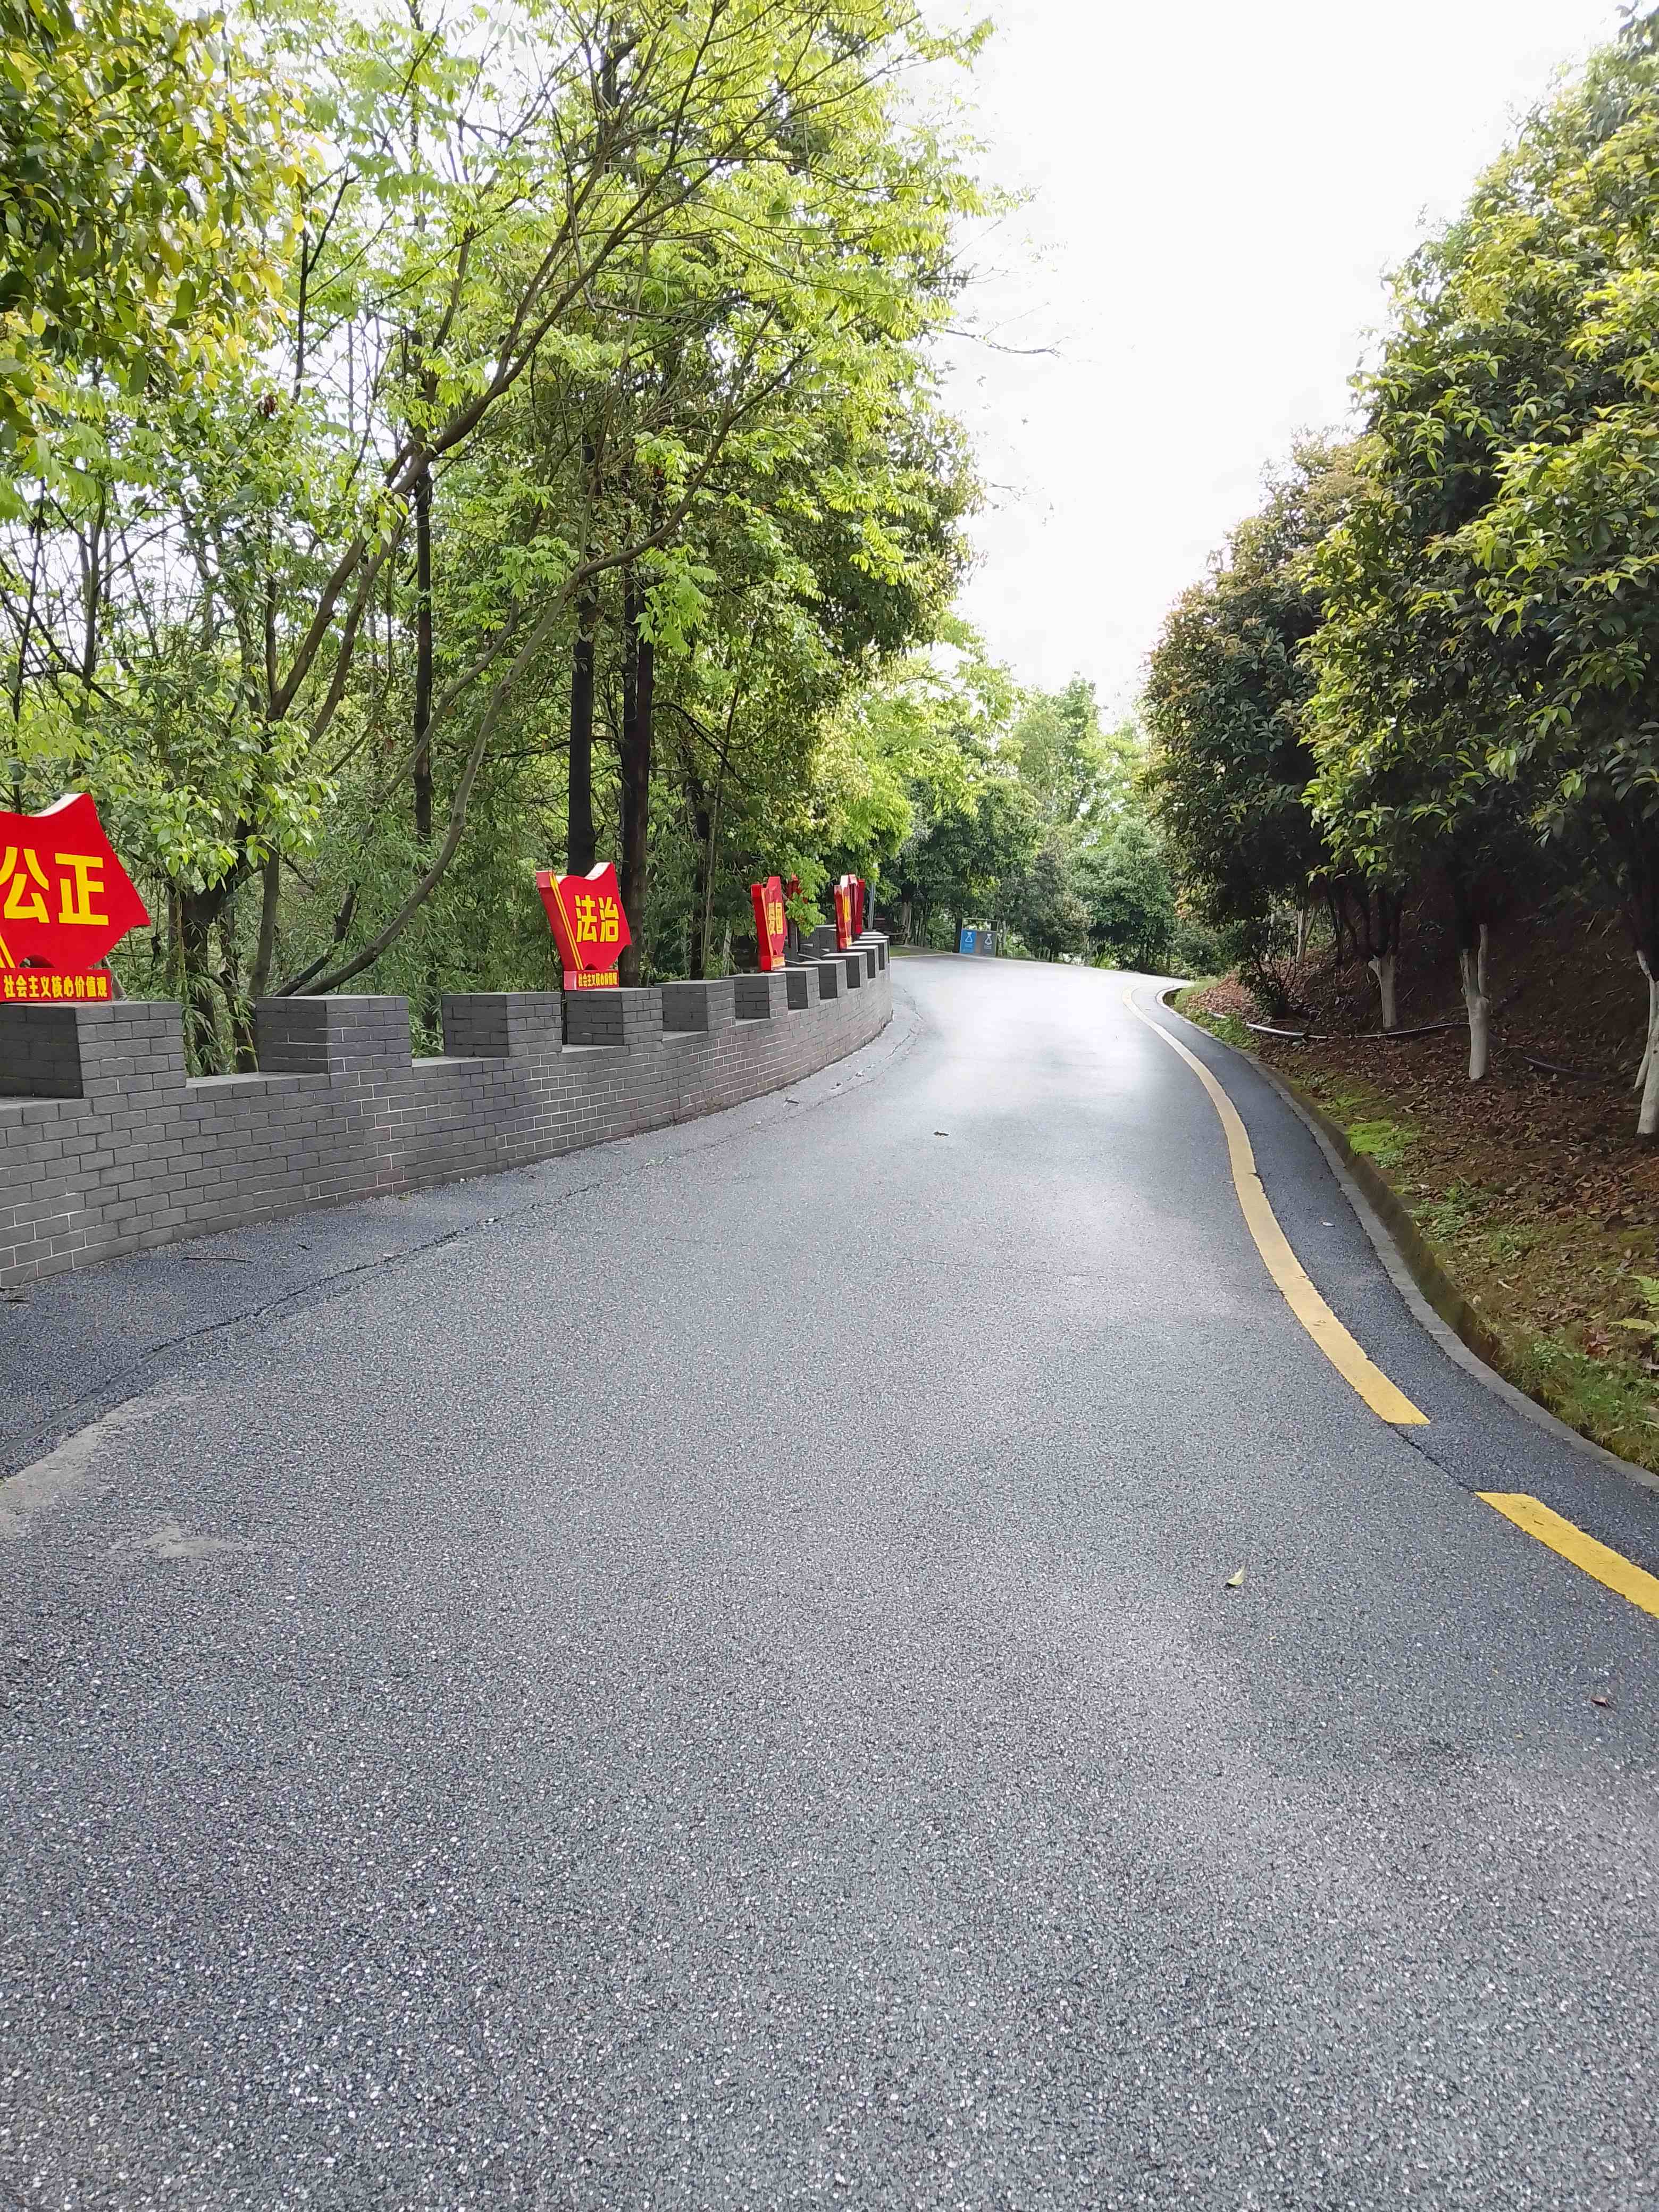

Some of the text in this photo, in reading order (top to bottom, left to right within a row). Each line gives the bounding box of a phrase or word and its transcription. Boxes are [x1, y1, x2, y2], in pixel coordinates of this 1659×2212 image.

[0, 846, 109, 925] 公正
[574, 894, 619, 943] 法治
[3, 975, 108, 999] 社会主义核心价值观
